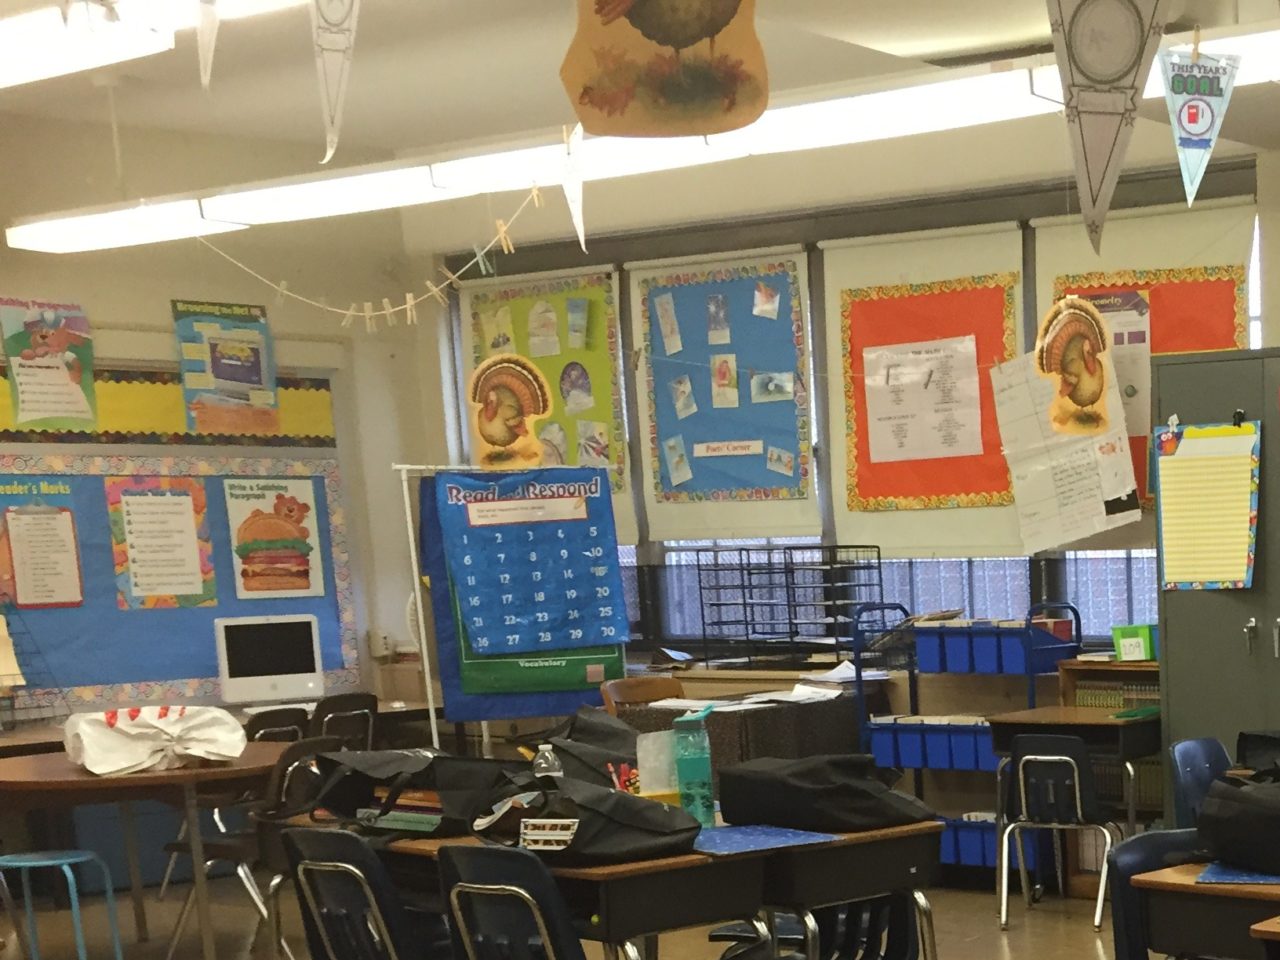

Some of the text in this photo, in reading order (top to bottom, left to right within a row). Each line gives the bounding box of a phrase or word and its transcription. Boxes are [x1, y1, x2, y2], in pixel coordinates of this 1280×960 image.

[1170, 62, 1228, 75] THIS YEAR'S
[1171, 73, 1224, 97] GOAL
[447, 482, 498, 504] Read
[525, 476, 601, 498] Respond
[590, 527, 597, 537] 5
[463, 535, 468, 544] 1
[495, 533, 503, 543] 2
[530, 552, 536, 561] 8
[560, 550, 568, 559] 9
[591, 547, 603, 557] 10
[464, 555, 472, 565] 6
[498, 554, 505, 563] 7
[532, 572, 542, 581] 13
[534, 592, 545, 602] 18
[566, 589, 577, 599] 19
[596, 587, 610, 598] 20
[469, 596, 480, 606] 16
[502, 595, 513, 604] 17
[536, 612, 548, 622] 23
[599, 607, 613, 617] 25
[504, 615, 516, 625] 22
[569, 629, 583, 639] 29
[601, 627, 615, 637] 30
[506, 634, 520, 645] 27
[539, 633, 551, 642] 28
[518, 659, 567, 668] Vocabulary
